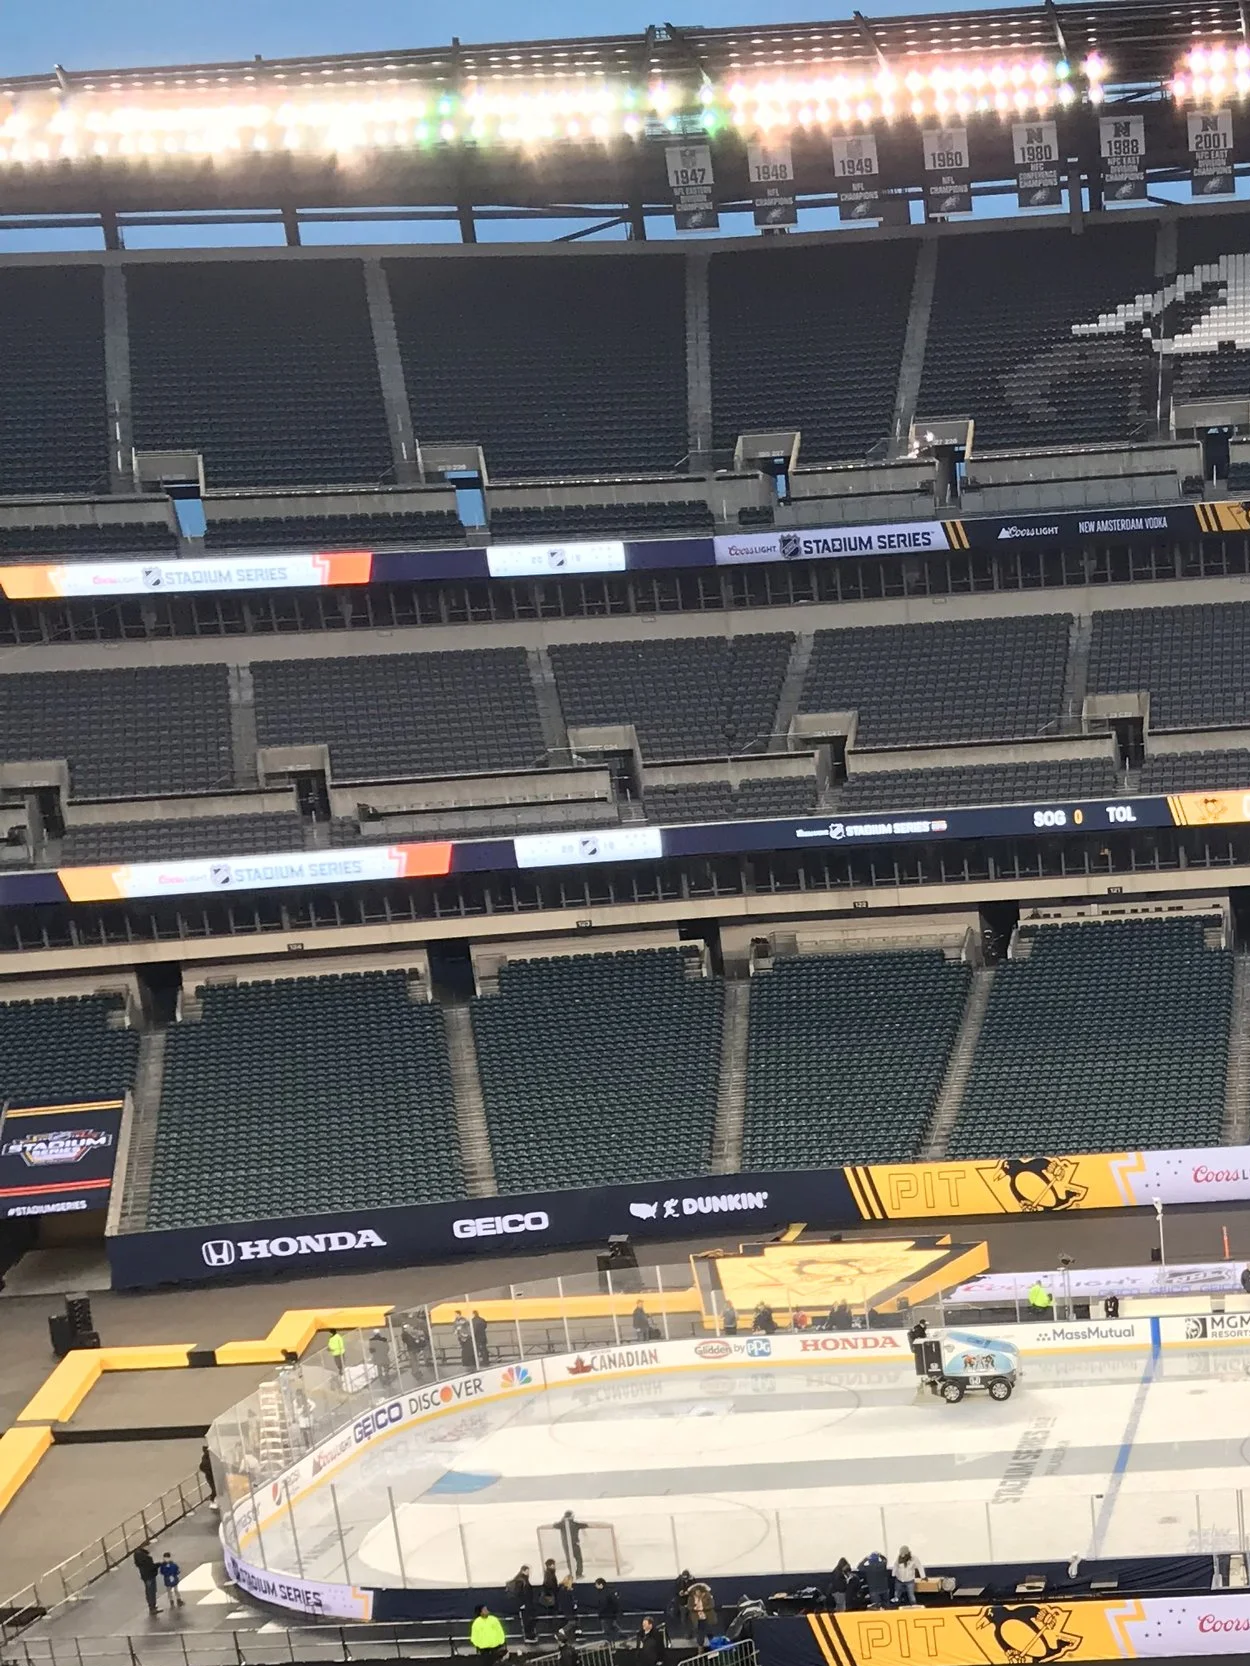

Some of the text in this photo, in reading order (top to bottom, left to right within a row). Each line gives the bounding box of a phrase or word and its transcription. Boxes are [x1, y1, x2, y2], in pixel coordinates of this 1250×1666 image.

[1107, 139, 1139, 155] 1988
[1195, 133, 1227, 149] 2001
[931, 152, 963, 168] 1960
[1020, 145, 1052, 162] 1980
[755, 164, 788, 180] 1948
[840, 158, 873, 175] 1949
[674, 168, 706, 185] 1947
[1008, 526, 1058, 538] Coors LIGHT
[1079, 517, 1167, 534] NEW AMSTERDAM VODKA
[755, 545, 776, 554] LIGHT
[804, 536, 873, 555] STADIUM
[878, 532, 931, 549] SERIES
[163, 567, 287, 585] STADIUM SERIES
[1034, 811, 1066, 827] SOG
[1106, 806, 1136, 823] TOL
[846, 824, 892, 838] STADIUM
[893, 821, 930, 834] SERIES
[235, 861, 363, 882] STADIUM SERIES
[8, 1136, 107, 1154] STADIUM
[1192, 1165, 1241, 1184] Coors
[889, 1169, 967, 1211] PIT
[7, 1200, 88, 1216] #STADIUMSERIES
[682, 1191, 768, 1216] DUNKIN'
[453, 1211, 549, 1240] GEICO
[238, 1229, 387, 1260] HONDA
[1052, 1325, 1135, 1341] MassMutual
[694, 1340, 771, 1357] Glidden by PPG
[801, 1335, 900, 1351] HONDA
[590, 1349, 659, 1372] CANADIAN
[408, 1378, 484, 1415] DISCOVER
[354, 1402, 403, 1443] GEICO
[238, 1567, 323, 1608] STADIUM SERIES
[1198, 1613, 1250, 1635] Coors
[858, 1616, 945, 1660] PIT
